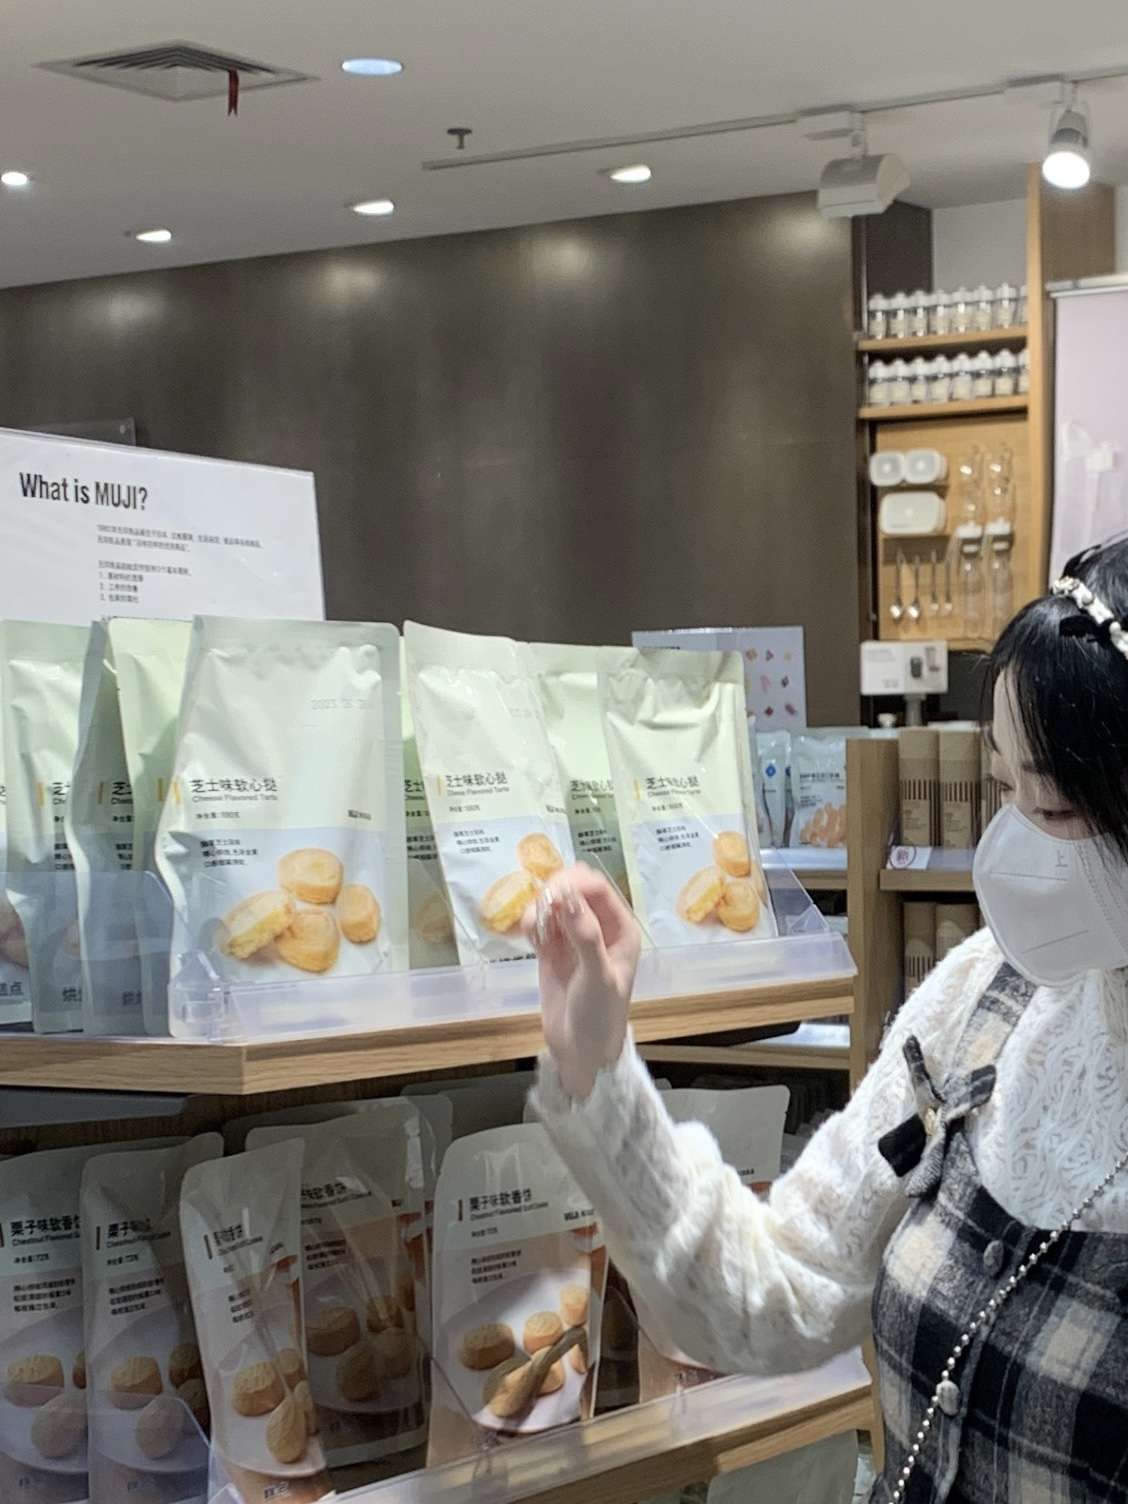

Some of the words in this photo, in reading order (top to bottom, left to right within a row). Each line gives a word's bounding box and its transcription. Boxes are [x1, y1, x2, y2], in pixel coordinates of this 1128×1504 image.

[19, 472, 69, 502] What
[74, 478, 91, 504] is
[95, 481, 147, 511] MUJI?
[190, 777, 278, 794] 芝士味软心挞
